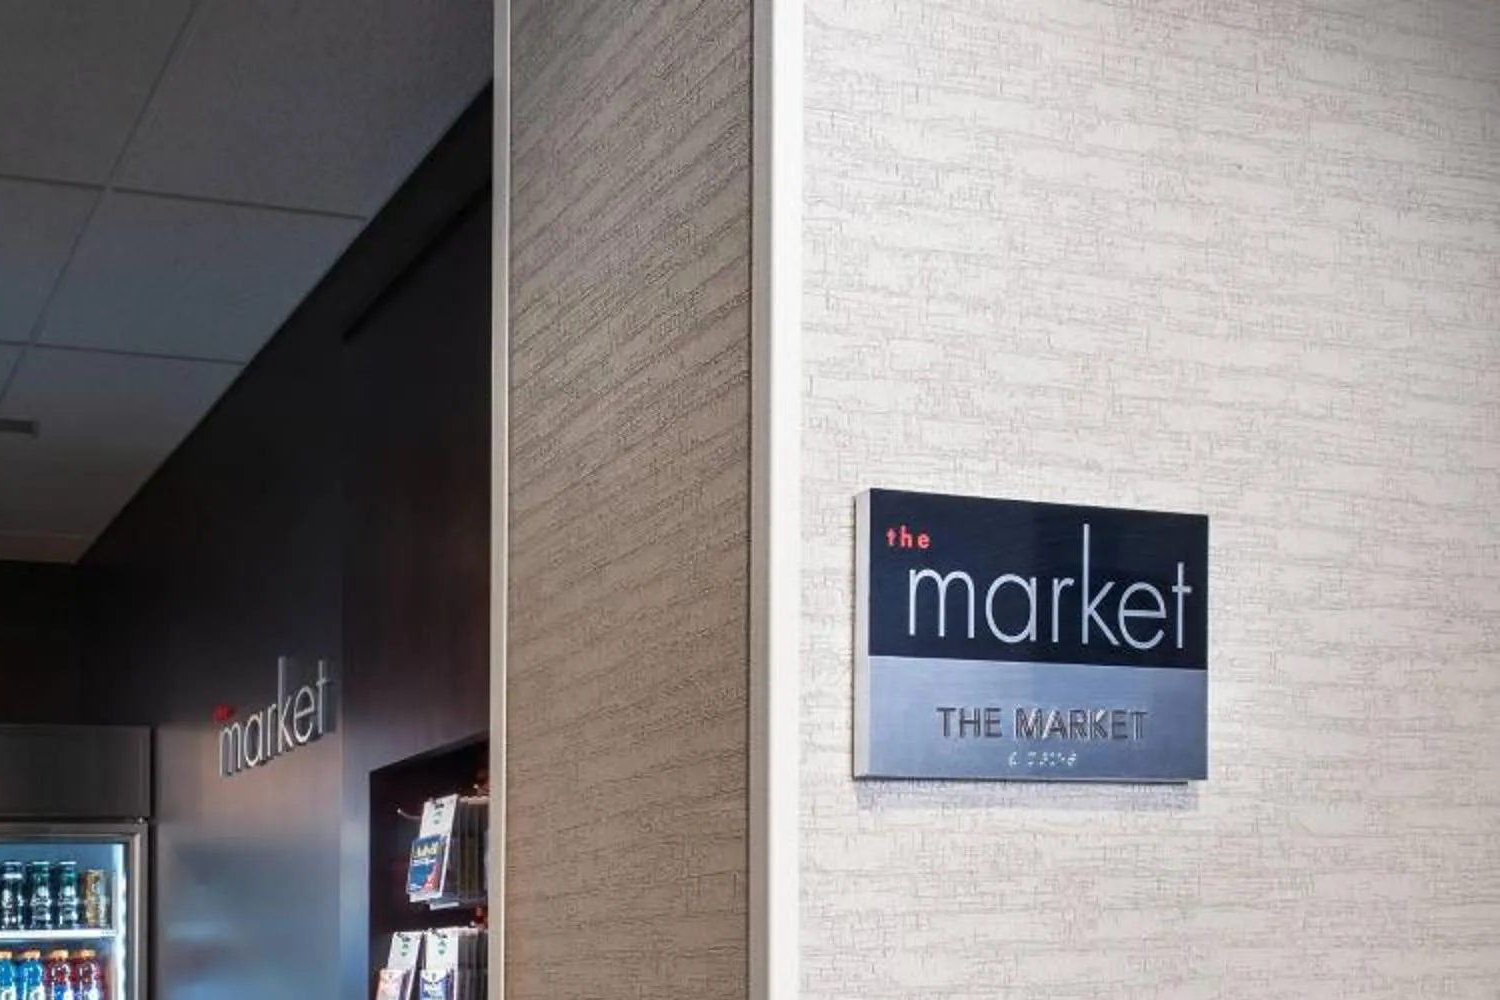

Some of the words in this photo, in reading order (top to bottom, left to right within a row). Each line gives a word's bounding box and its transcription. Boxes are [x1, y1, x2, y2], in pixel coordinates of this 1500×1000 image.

[886, 526, 931, 549] the
[909, 523, 1192, 650] market
[219, 655, 327, 778] market
[936, 707, 1002, 739] THE
[1013, 706, 1148, 741] MARKET
